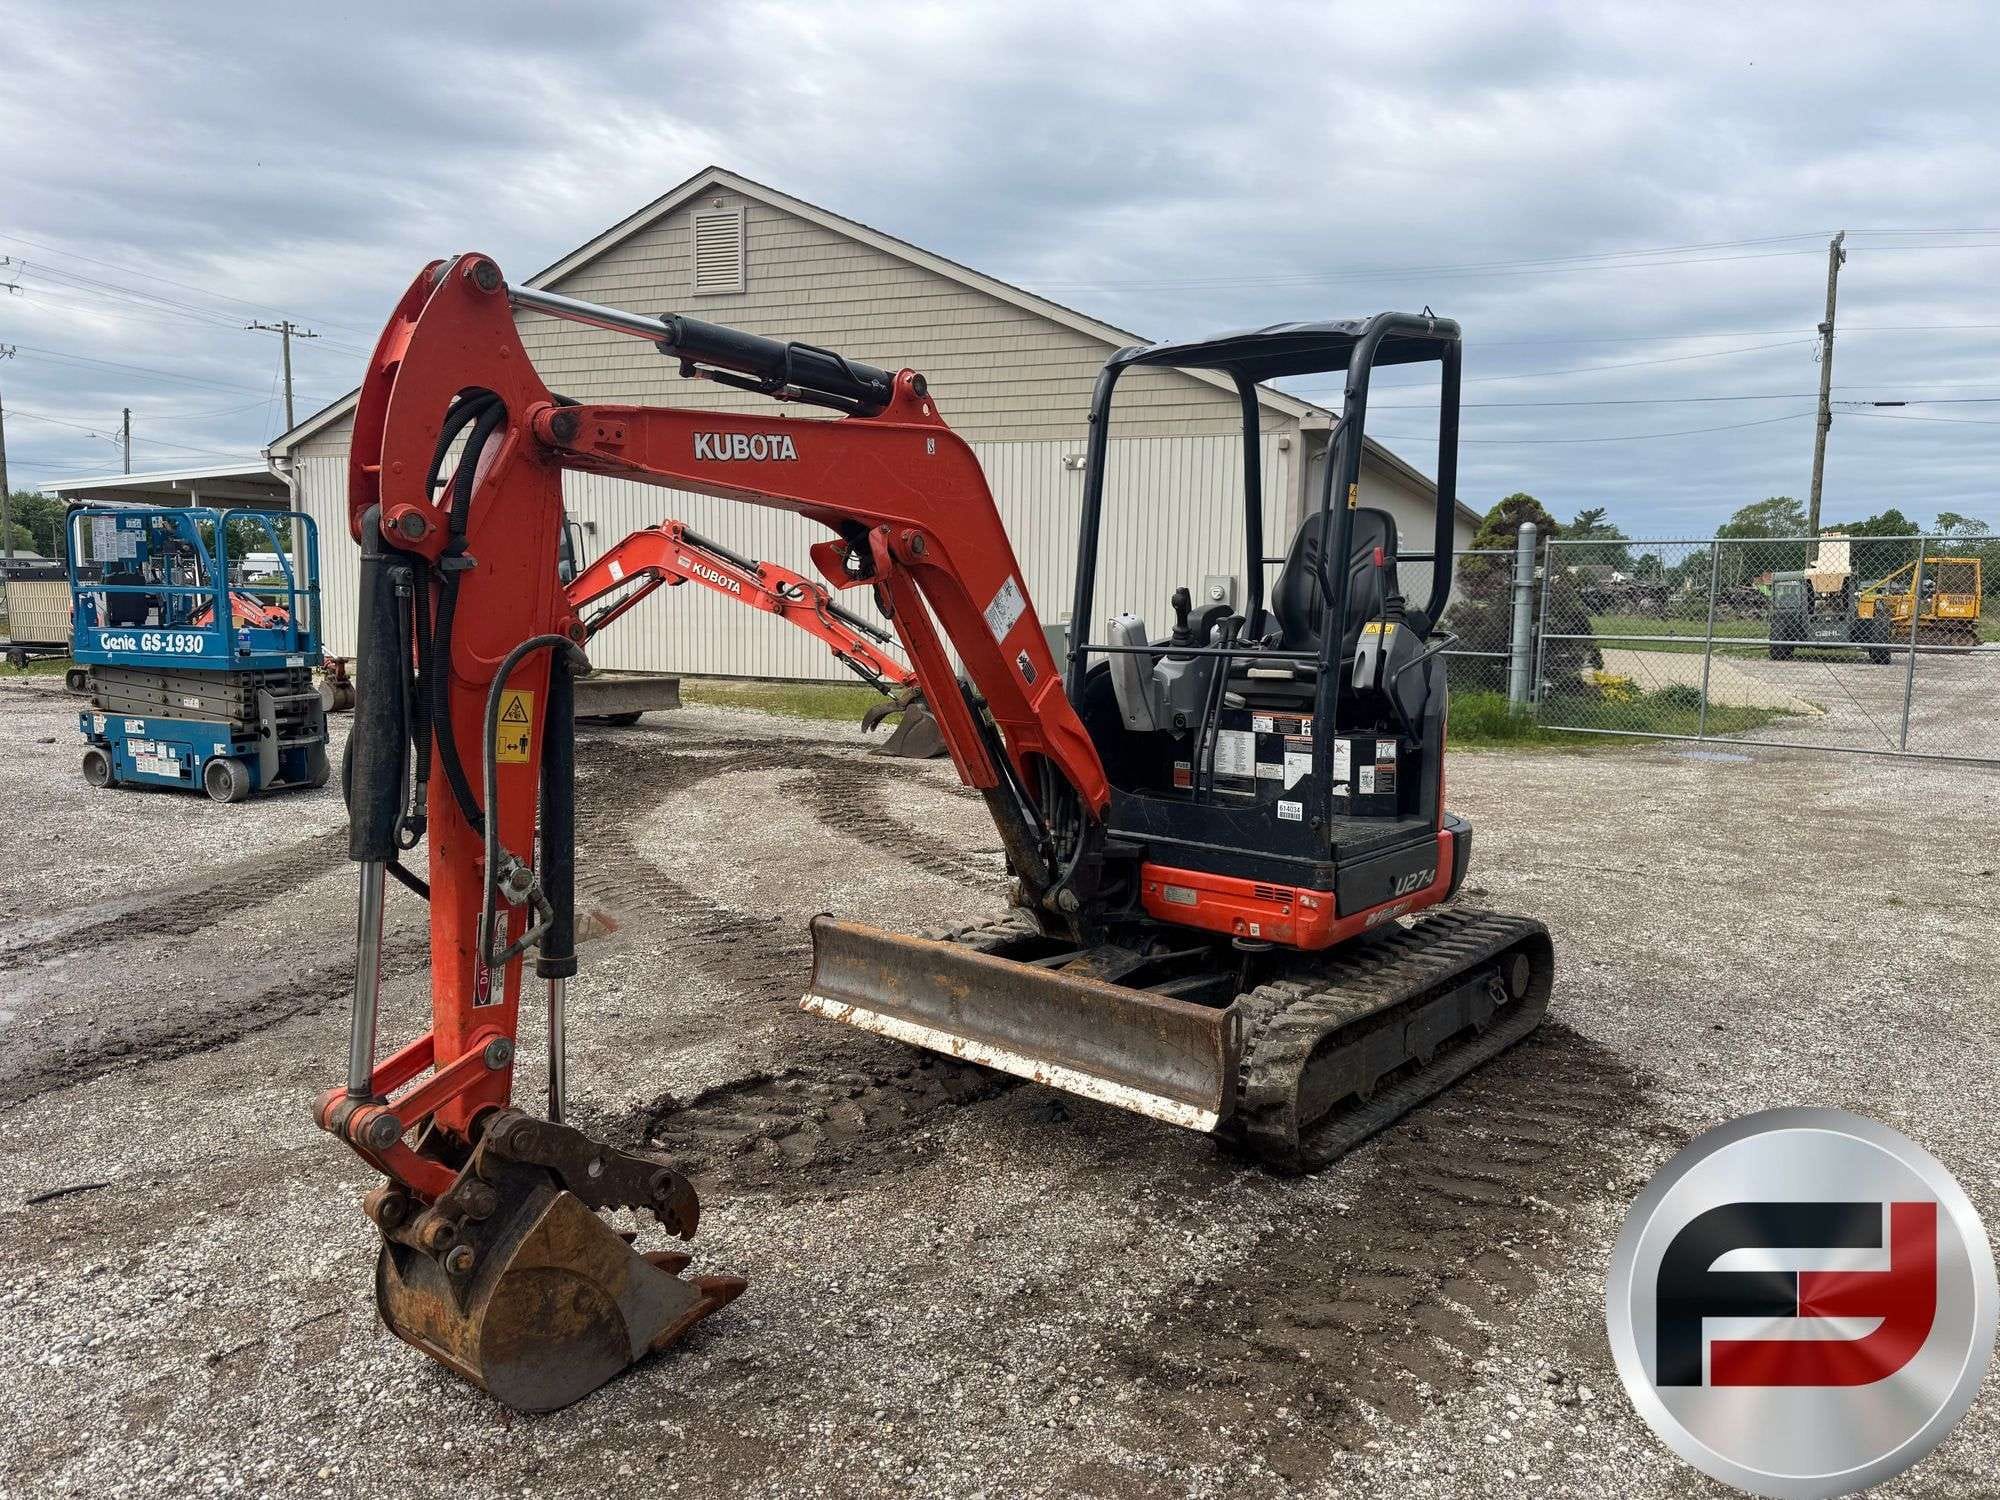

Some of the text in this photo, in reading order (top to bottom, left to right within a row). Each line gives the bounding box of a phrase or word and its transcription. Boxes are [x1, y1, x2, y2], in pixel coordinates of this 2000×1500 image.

[693, 432, 798, 461] KUBOTA
[692, 562, 741, 594] KUBOTA
[100, 633, 204, 654] Genie GS-1930
[1279, 804, 1301, 813] 614034
